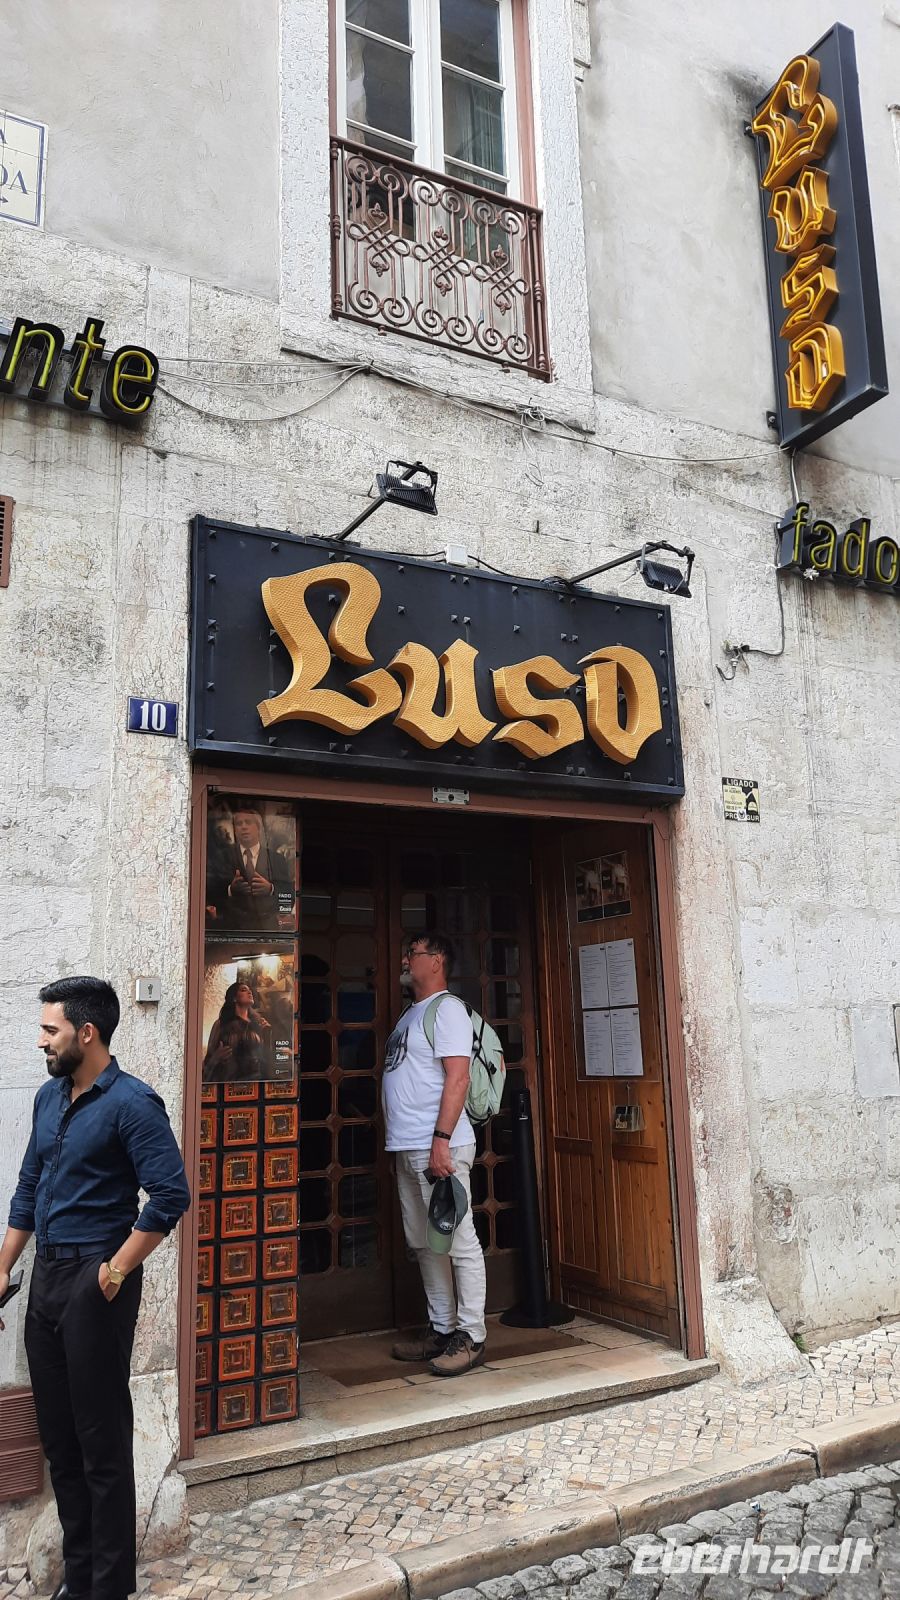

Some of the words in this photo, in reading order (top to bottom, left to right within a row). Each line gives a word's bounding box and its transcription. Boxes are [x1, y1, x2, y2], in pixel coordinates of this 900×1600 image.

[752, 54, 846, 411] Luso
[789, 501, 900, 588] fado
[256, 562, 662, 765] Luso
[140, 701, 166, 731] 10
[726, 778, 754, 788] LIGADO
[725, 812, 760, 822] PROGUR
